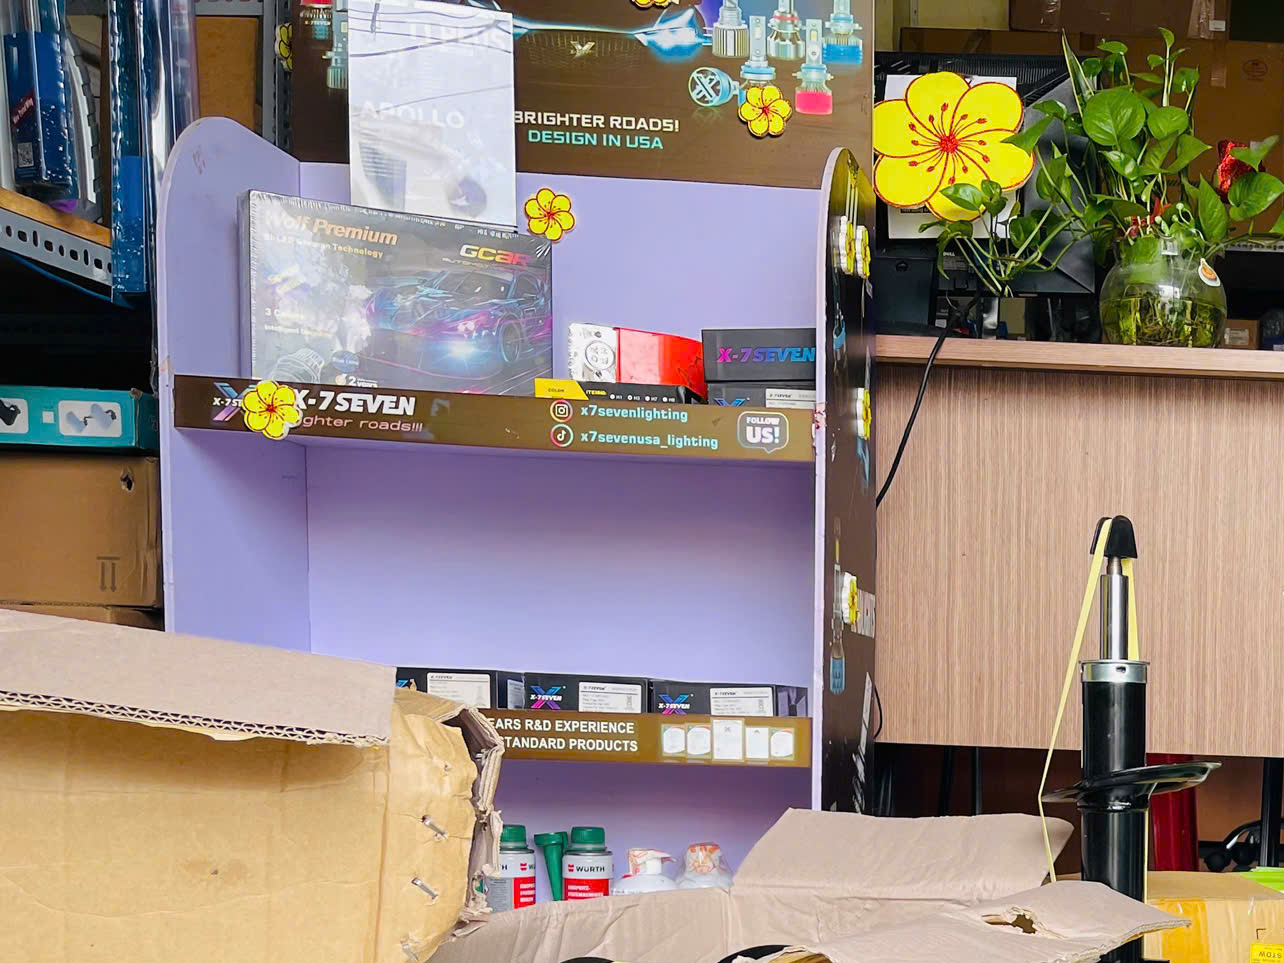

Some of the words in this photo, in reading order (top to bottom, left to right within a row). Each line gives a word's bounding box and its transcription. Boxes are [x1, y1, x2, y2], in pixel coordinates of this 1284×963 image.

[609, 116, 680, 132] ROADS!
[528, 130, 598, 146] DESIGN
[602, 134, 621, 147] IN
[626, 135, 664, 150] USA
[313, 218, 399, 246] Premium
[716, 347, 817, 363] X-7SEVEN
[581, 404, 688, 422] x7sevenlighting
[746, 416, 780, 425] FOLLOW
[359, 417, 424, 432] roads!!!
[581, 429, 718, 450] x7sevenusa_lighting
[746, 426, 779, 444] US!
[524, 719, 552, 731] R&D
[555, 720, 635, 734] EXPERIENCE
[569, 739, 638, 752] PRODUCTS
